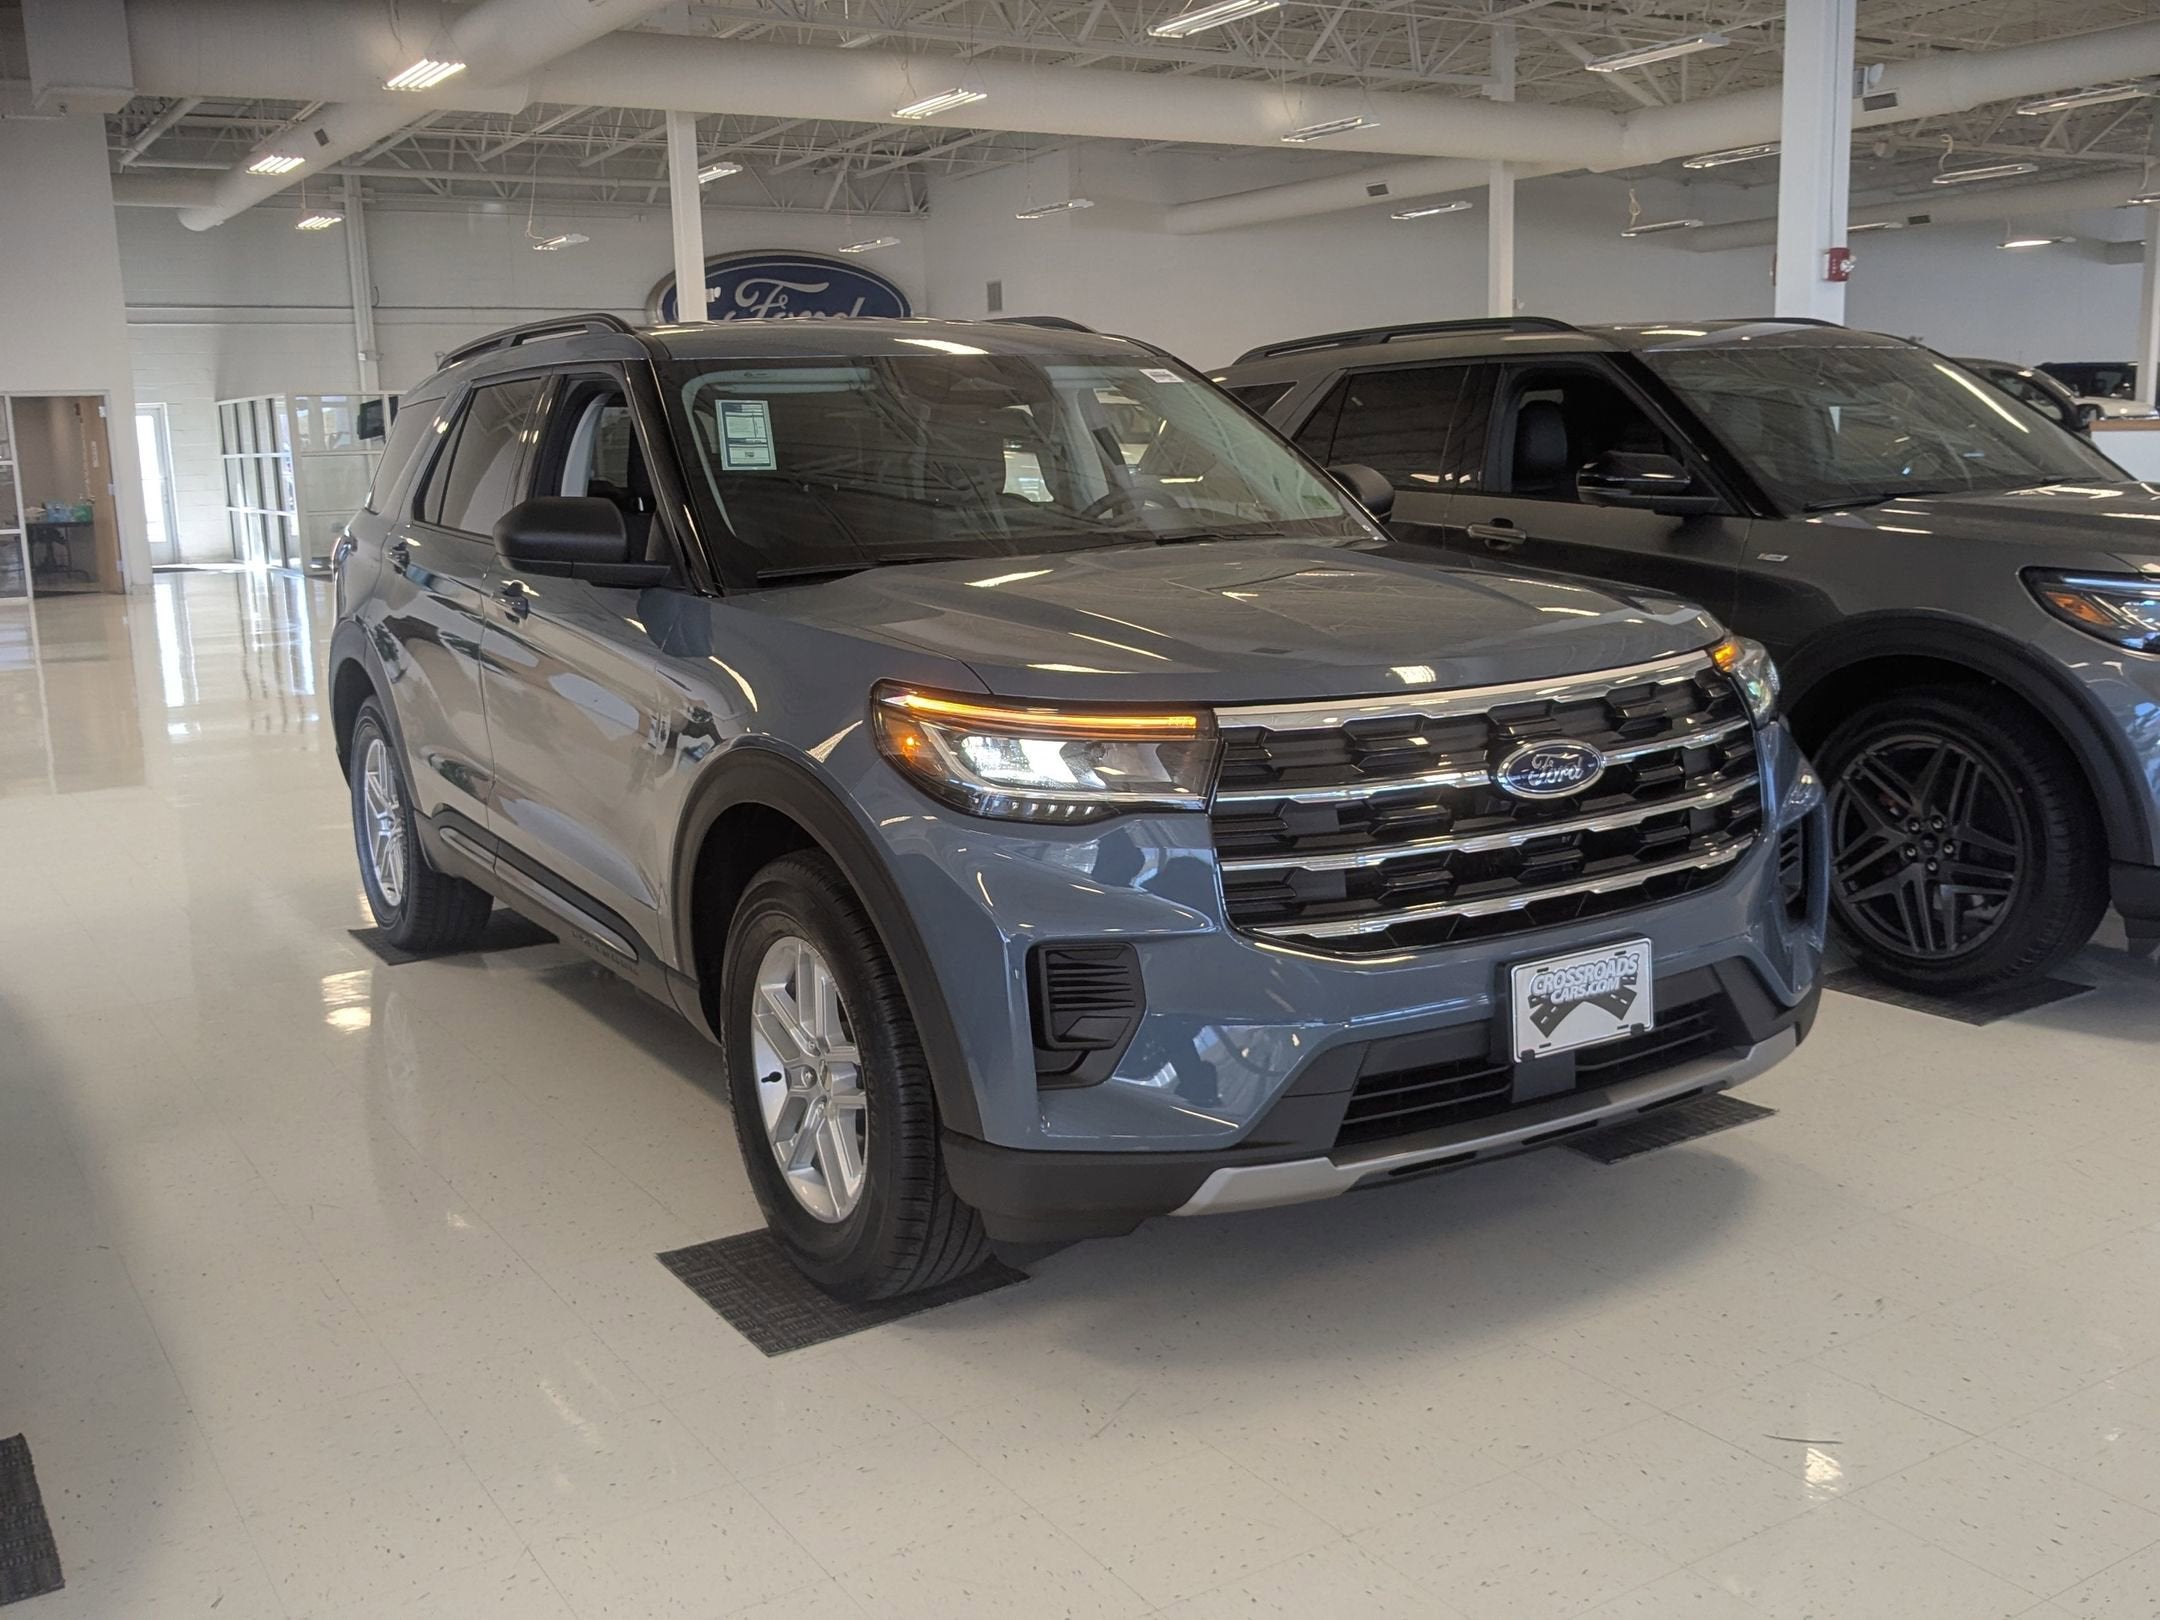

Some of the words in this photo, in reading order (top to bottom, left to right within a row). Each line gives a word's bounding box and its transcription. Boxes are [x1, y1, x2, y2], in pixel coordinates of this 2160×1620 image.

[722, 278, 866, 320] Fd
[1528, 753, 1584, 786] Ford
[1531, 952, 1640, 997] CROSSROADS
[1550, 976, 1620, 1005] CARS.COM
